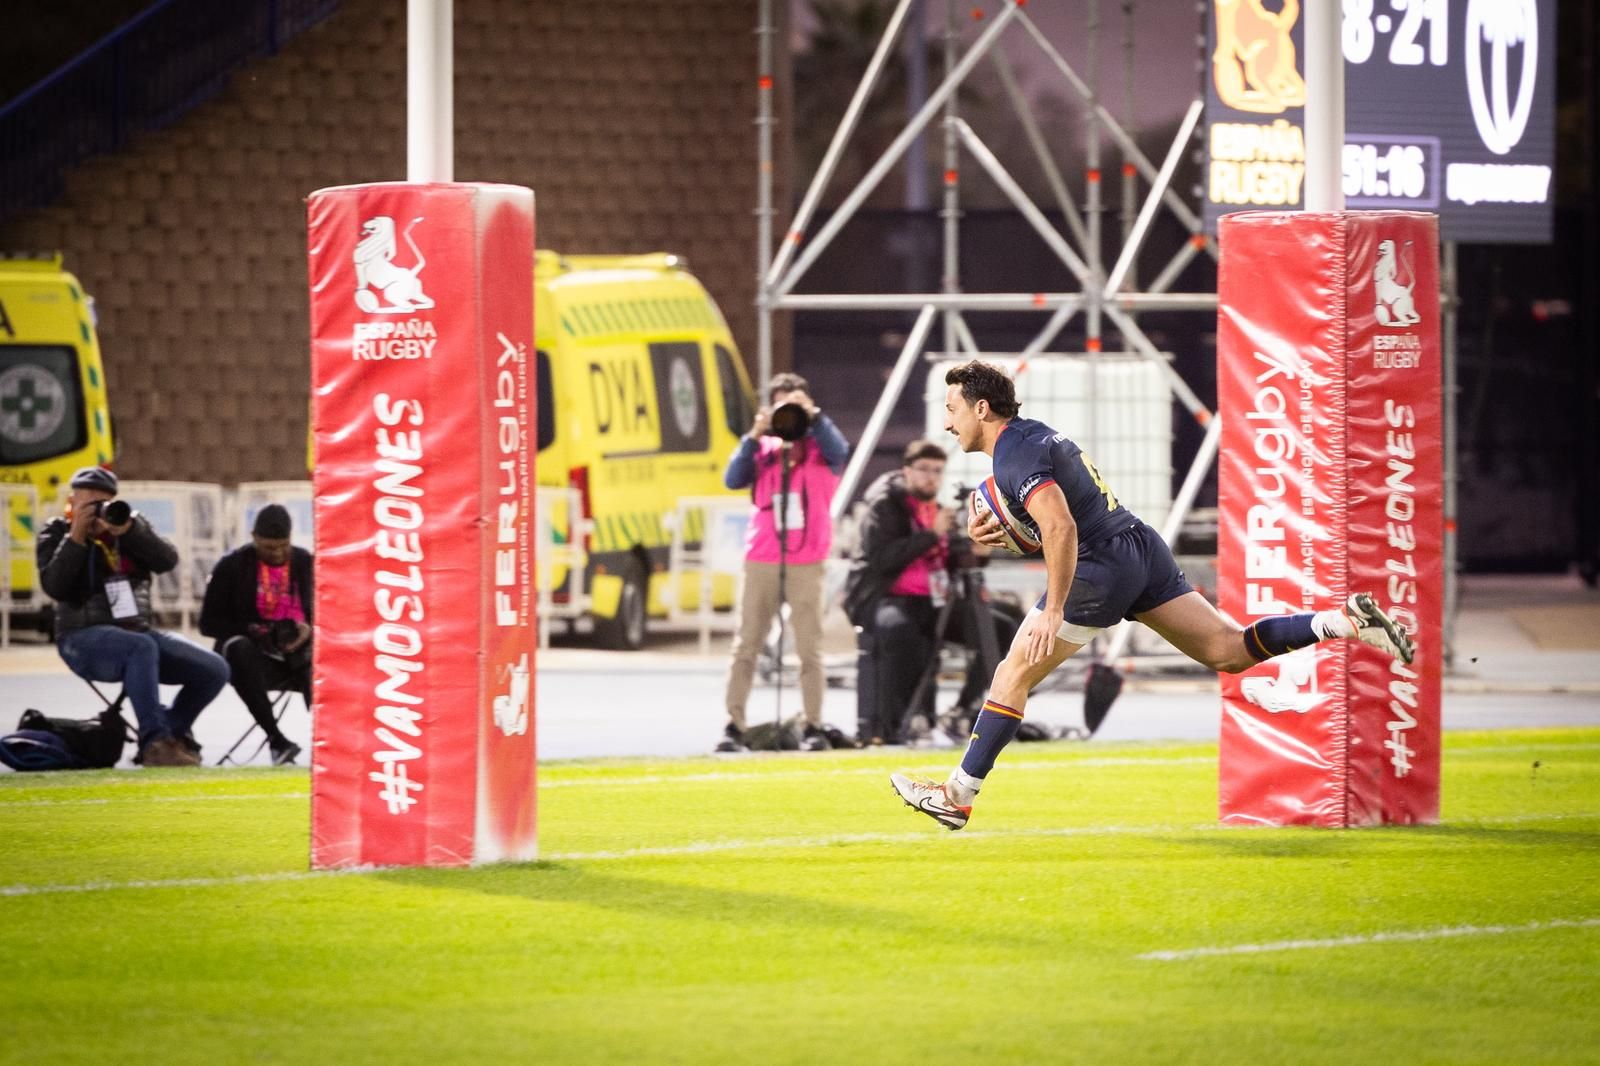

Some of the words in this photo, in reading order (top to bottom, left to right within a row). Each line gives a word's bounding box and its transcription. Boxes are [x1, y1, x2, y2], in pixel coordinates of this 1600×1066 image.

[1209, 160, 1305, 205] RUGBY
[352, 339, 437, 360] RUGBY
[353, 318, 437, 341] ESPAÑA
[1373, 332, 1422, 350] ESPAÑA
[518, 342, 527, 399] RUGBY
[1373, 351, 1422, 369] RUGBY
[588, 358, 652, 434] DYA
[494, 332, 519, 627] FERugby
[1244, 352, 1296, 616] FERugby
[369, 393, 424, 815] #VAMOSLEONES
